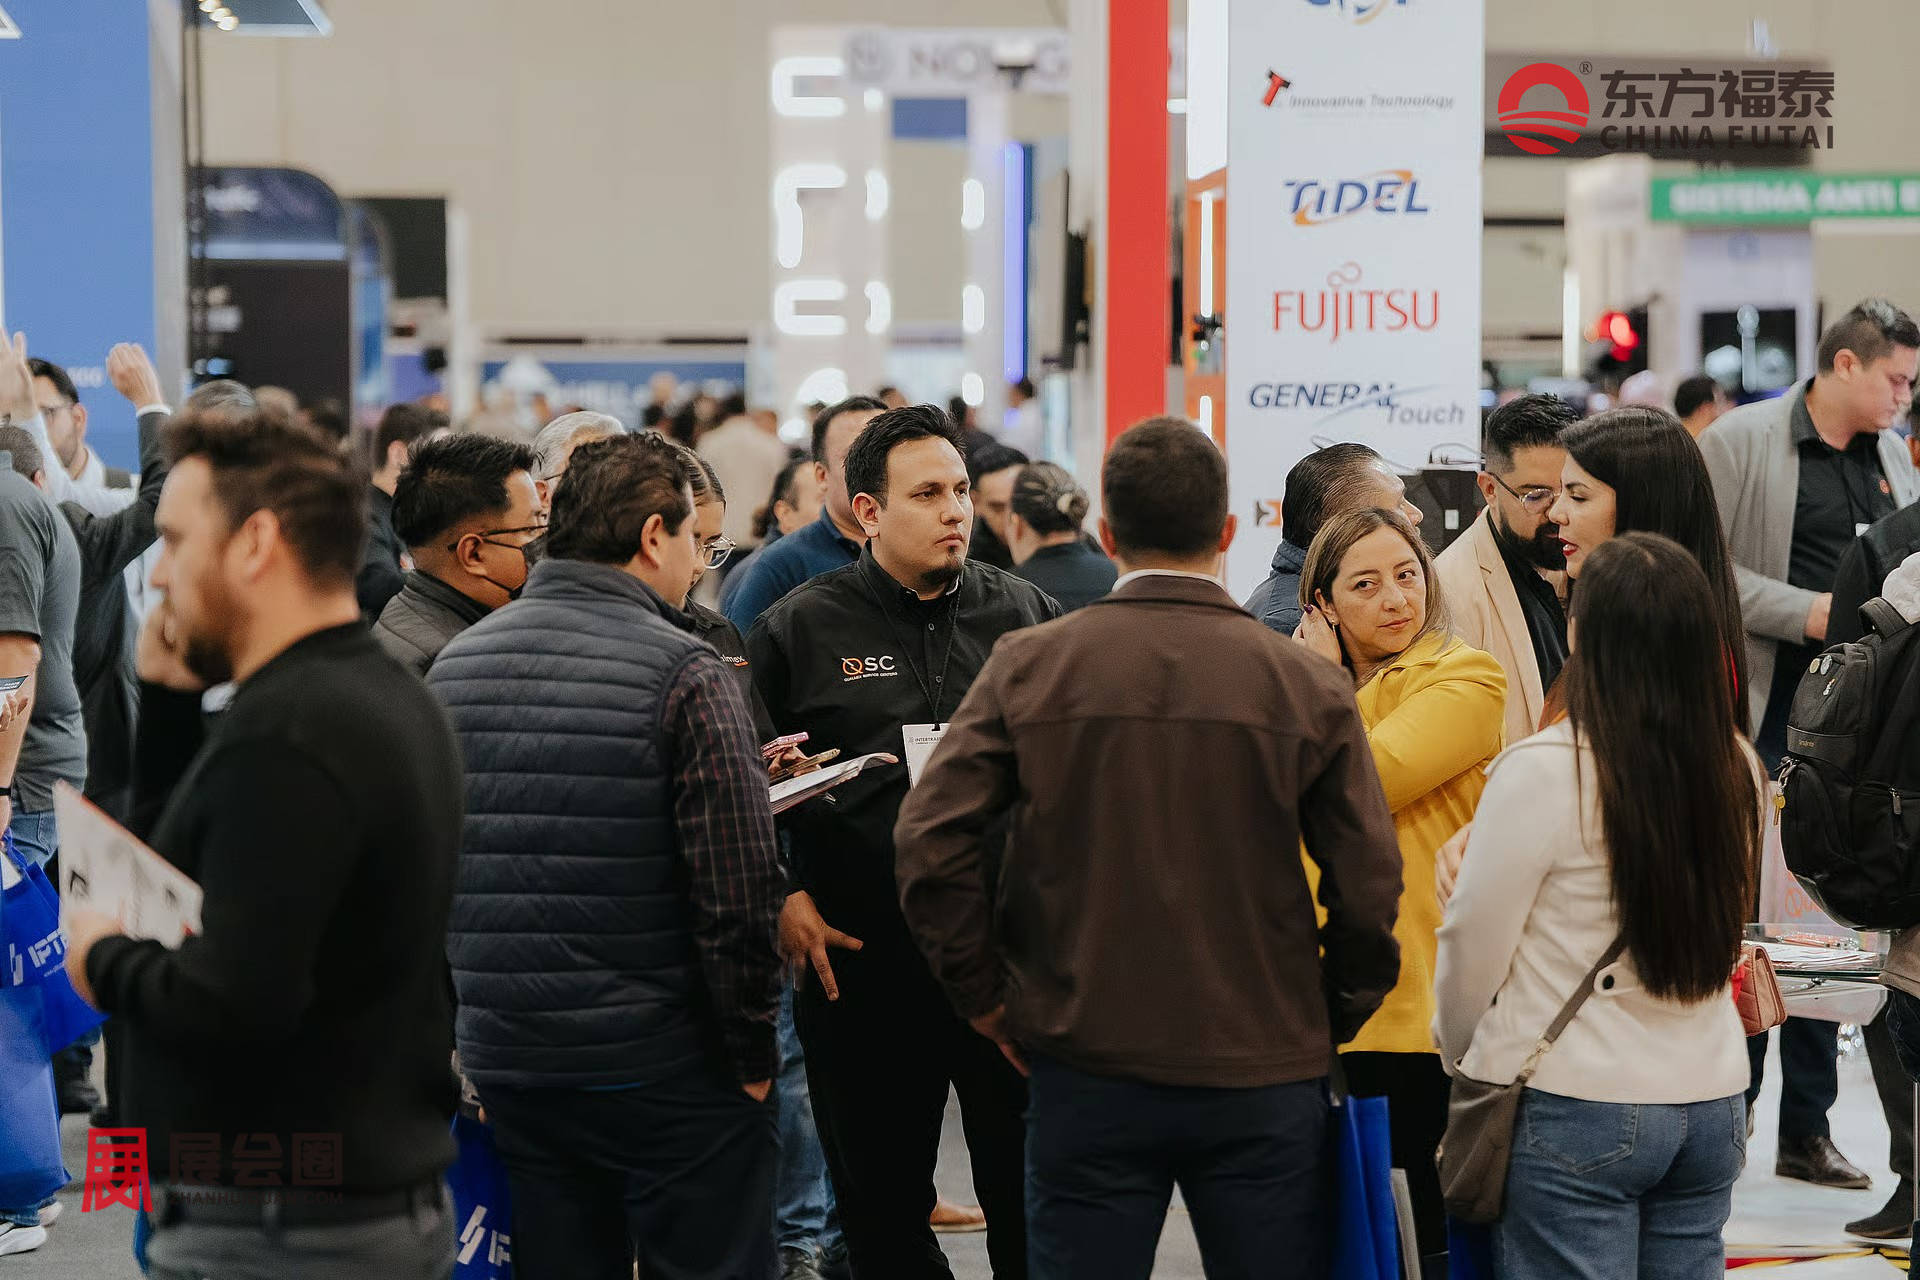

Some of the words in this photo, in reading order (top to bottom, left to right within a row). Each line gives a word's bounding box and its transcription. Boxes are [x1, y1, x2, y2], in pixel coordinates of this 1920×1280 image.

[1288, 94, 1364, 108] Innovative
[1369, 93, 1454, 110] Technology
[1284, 178, 1429, 214] TIDEL
[1271, 288, 1440, 343] FUJITSU
[1249, 382, 1398, 409] GENERAL
[1386, 404, 1465, 425] Touch
[840, 655, 896, 676] QSC
